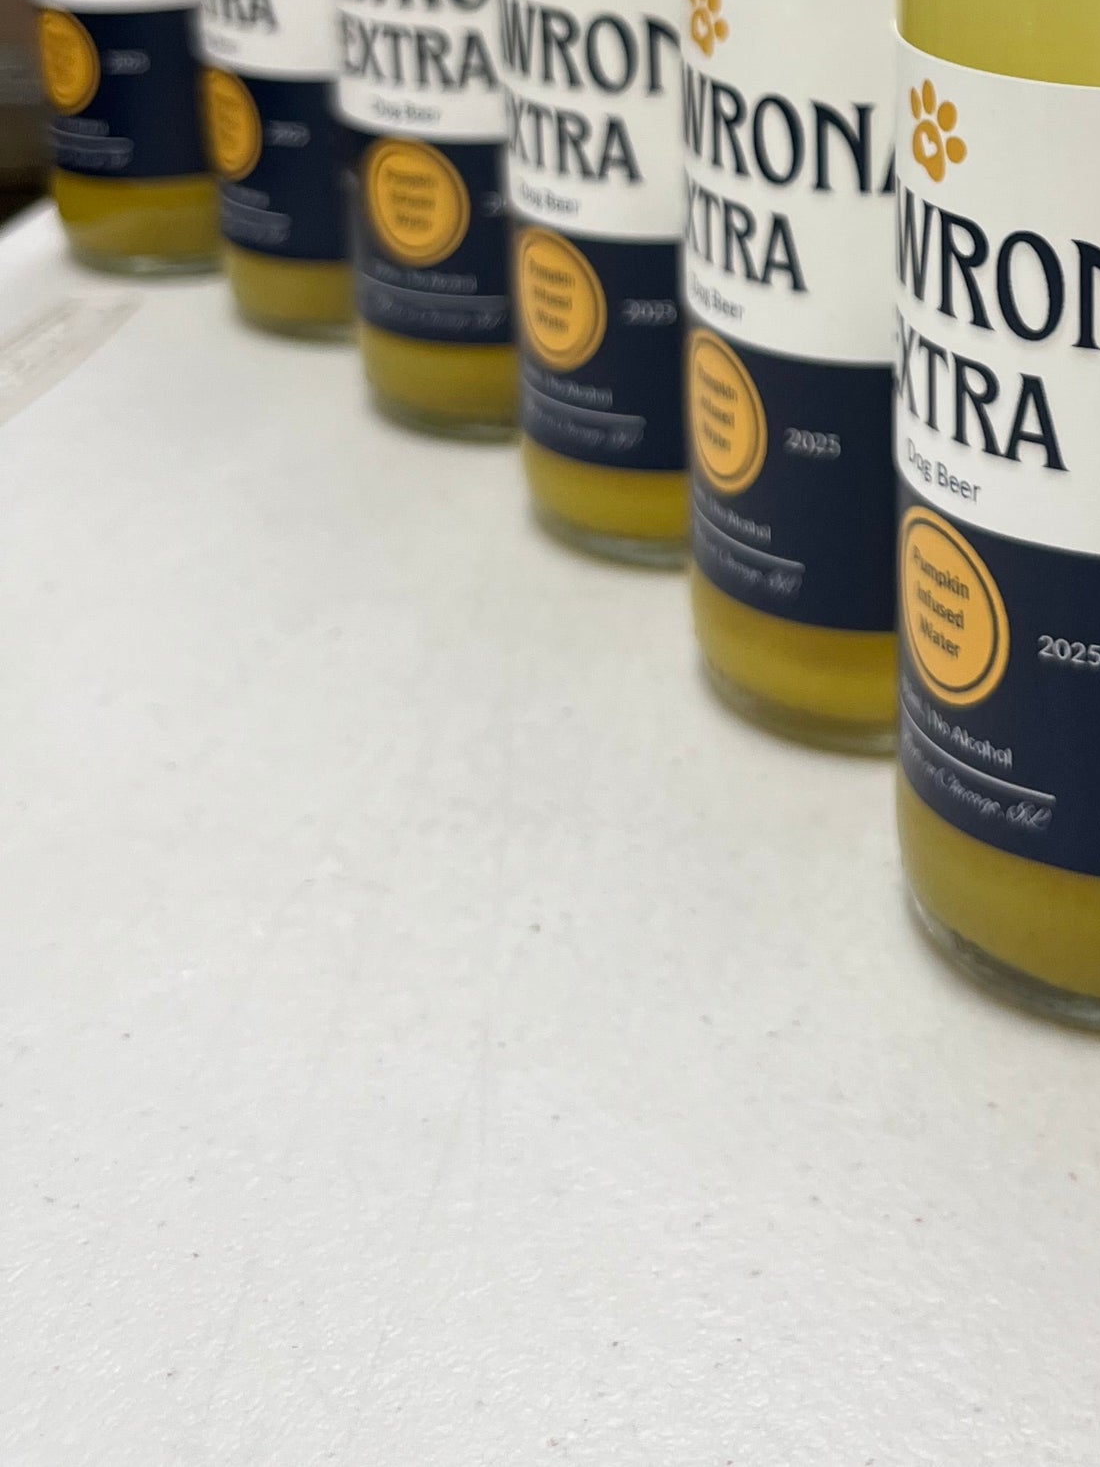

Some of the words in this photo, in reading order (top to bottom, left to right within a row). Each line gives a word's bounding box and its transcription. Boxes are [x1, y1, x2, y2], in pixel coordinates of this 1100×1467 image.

[907, 437, 932, 483] Dog
[937, 460, 982, 504] Beer
[912, 543, 970, 601] Pumpkin
[917, 585, 965, 632] Infused
[918, 617, 961, 659] Water
